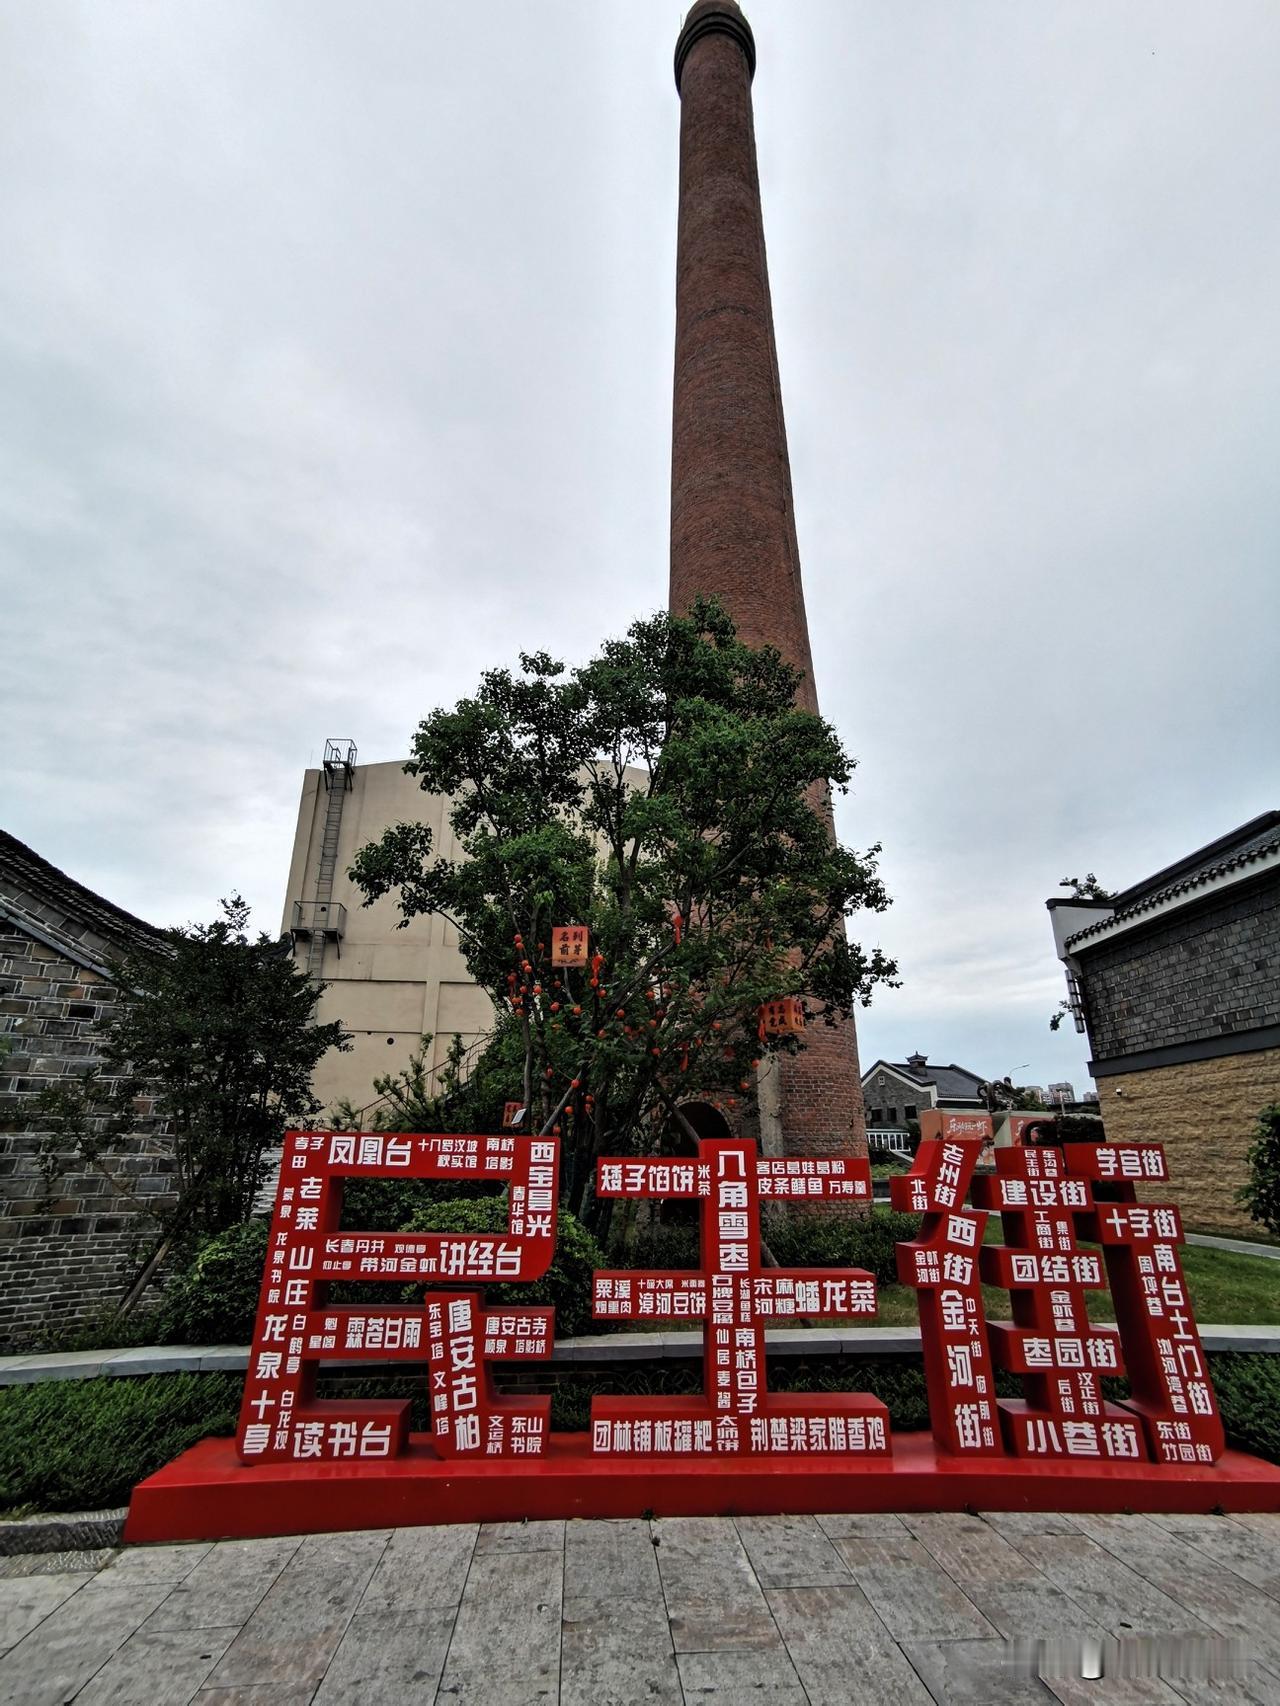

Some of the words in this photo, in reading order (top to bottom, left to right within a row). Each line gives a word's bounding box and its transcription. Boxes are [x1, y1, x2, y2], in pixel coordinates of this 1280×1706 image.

[295, 1137, 325, 1150] 孝子
[328, 1136, 412, 1166] 凤凰台
[418, 1139, 478, 1152] 十八罗汉坡
[486, 1138, 515, 1152] 南桥
[292, 1155, 307, 1168] 田
[484, 1156, 514, 1170] 塔影
[756, 1161, 845, 1175] 客店葛娃葛粉
[1024, 1149, 1040, 1177] 民主街
[1096, 1148, 1164, 1177] 学宫街
[526, 1142, 555, 1237] 西宝昙光
[601, 1164, 694, 1192] 矮子馅饼
[698, 1164, 711, 1196] 米茶
[758, 1178, 823, 1195] 皮条鳝鱼
[1000, 1179, 1087, 1206] 建设街
[511, 1186, 525, 1235] 春华馆
[910, 1179, 928, 1210] 北街
[717, 1150, 749, 1272] 八角雪枣
[1106, 1208, 1178, 1238] 十字街
[284, 1177, 322, 1305] 老莱山庄
[1034, 1210, 1054, 1249] 工商街
[1056, 1221, 1071, 1251] 集街
[326, 1239, 384, 1253] 长春丹井
[440, 1240, 522, 1275] 讲经台
[915, 1250, 939, 1266] 金虾
[943, 1214, 977, 1286] 西街
[267, 1232, 289, 1304] 龙泉书院
[360, 1257, 437, 1273] 带河金虾
[916, 1268, 940, 1283] 河街
[1011, 1255, 1100, 1283] 团结街
[638, 1291, 706, 1315] 漳河豆饼
[711, 1274, 734, 1325] 石牌豆腐
[739, 1278, 751, 1323] 长湖鱼糕
[795, 1280, 876, 1313] 蟠龙菜
[1050, 1290, 1076, 1332] 金虾巷
[345, 1317, 422, 1349] 霖苍甘雨
[428, 1303, 444, 1360] 东宝塔
[485, 1317, 547, 1335] 唐安古寺
[965, 1298, 982, 1358] 中天街
[484, 1339, 507, 1354] 顺泉
[1022, 1338, 1117, 1368] 枣园街
[243, 1314, 289, 1454] 龙泉十亭
[448, 1299, 480, 1451] 唐安古柏
[716, 1328, 731, 1409] 仙居麦酱
[735, 1328, 758, 1414] 南桥包子
[940, 1290, 981, 1448] 金河街
[433, 1371, 450, 1436] 文峰塔
[1058, 1379, 1075, 1413] 后街
[1077, 1372, 1099, 1416] 汉正街
[273, 1390, 294, 1450] 白龙观
[511, 1416, 543, 1433] 东山
[976, 1375, 994, 1447] 府前街
[293, 1421, 391, 1458] 读书台
[486, 1415, 504, 1454] 文运桥
[511, 1436, 542, 1453] 书院
[750, 1417, 886, 1451] 荆楚梁家腊香鸡
[1026, 1420, 1139, 1457] 小巷街
[1156, 1421, 1191, 1440] 东街
[1162, 1443, 1212, 1462] 竹园街
